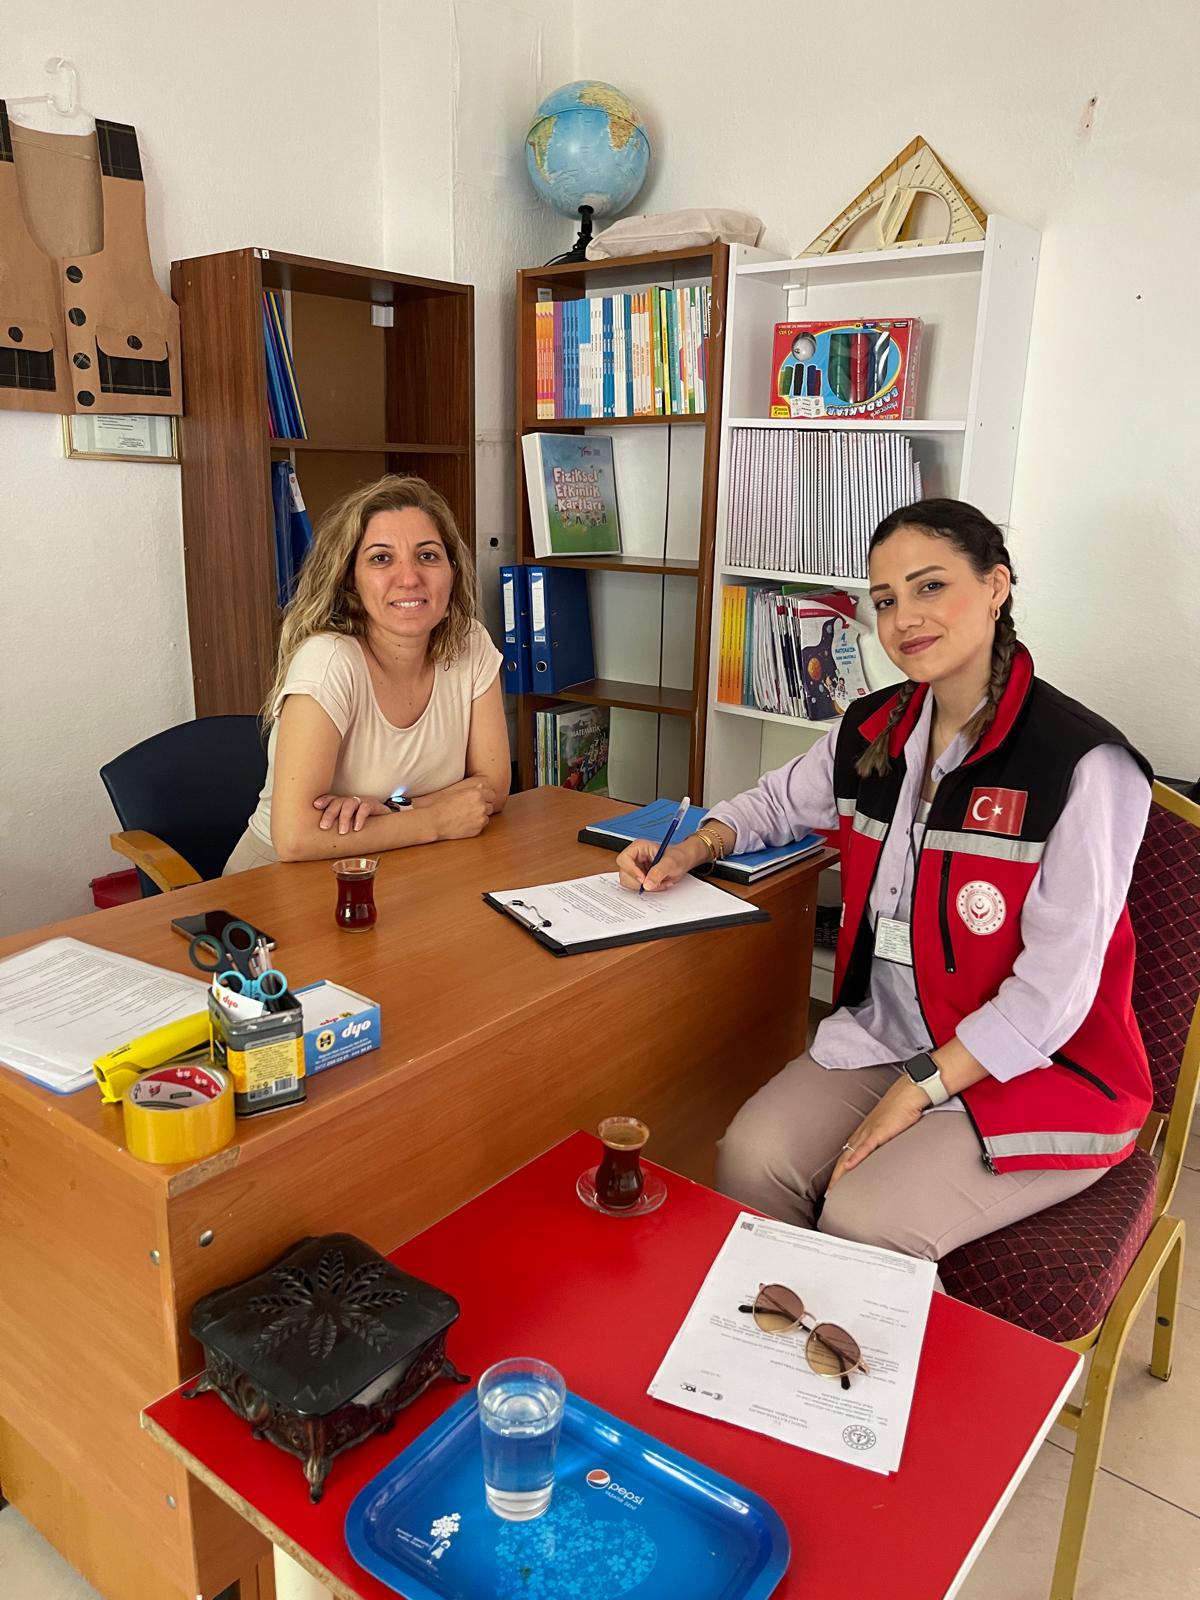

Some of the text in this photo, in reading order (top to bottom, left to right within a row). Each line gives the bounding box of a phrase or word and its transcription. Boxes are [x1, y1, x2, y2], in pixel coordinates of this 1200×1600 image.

[827, 386, 899, 416] BARDAKLAR
[553, 466, 599, 484] Fiziksel
[555, 484, 601, 499] Etkinlik
[557, 497, 602, 513] Kartları
[222, 995, 239, 1009] dyo
[341, 1019, 372, 1039] dyo
[609, 1483, 644, 1504] pepsi
